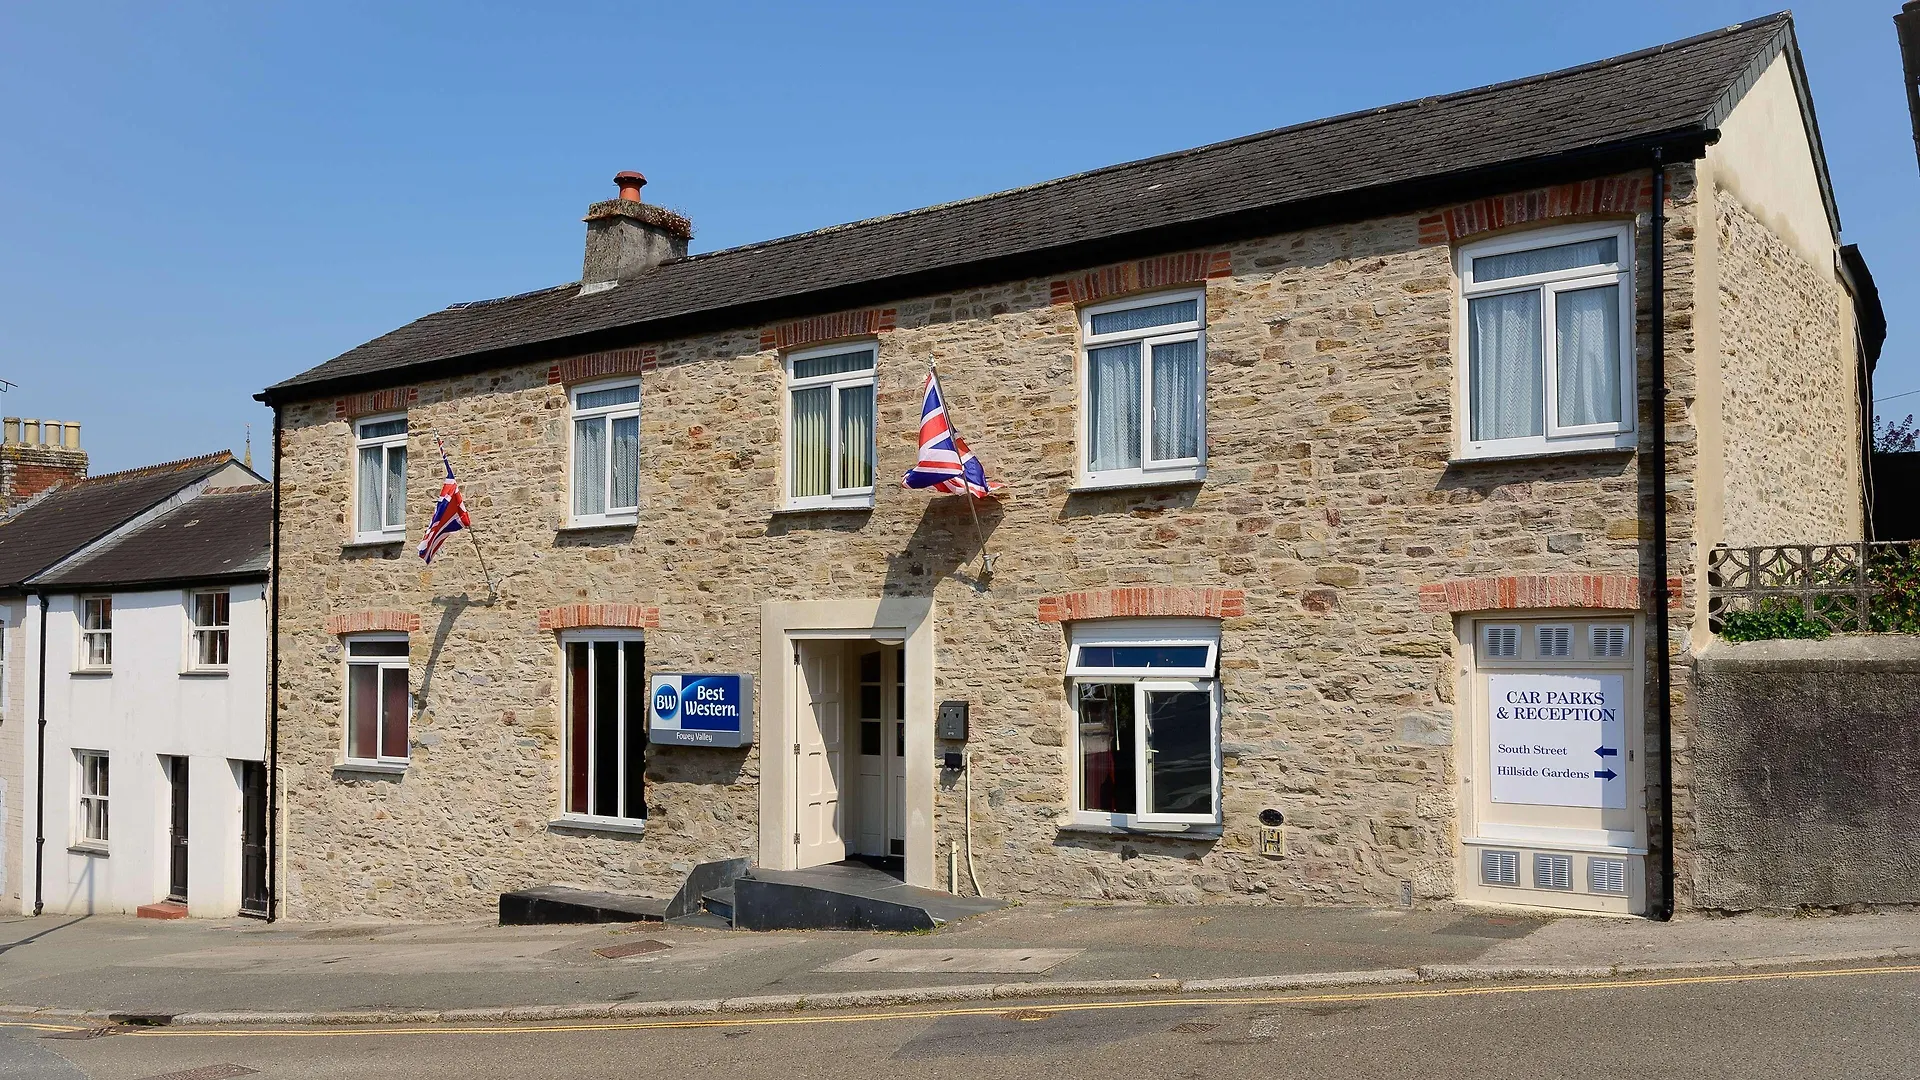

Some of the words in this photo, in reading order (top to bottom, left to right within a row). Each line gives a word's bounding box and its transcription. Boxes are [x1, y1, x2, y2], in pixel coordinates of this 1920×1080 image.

[697, 685, 725, 701] Best
[1506, 691, 1542, 705] CAR
[1546, 691, 1605, 706] PARKS
[656, 694, 677, 710] BW
[1496, 706, 1510, 720] &
[1513, 707, 1617, 722] RECEPTION
[676, 731, 695, 742] Fowey
[695, 732, 713, 743] Valley
[1497, 743, 1531, 755] South
[1533, 744, 1568, 756] Street
[1497, 765, 1539, 777] Hillside
[1541, 767, 1590, 779] Gardens
